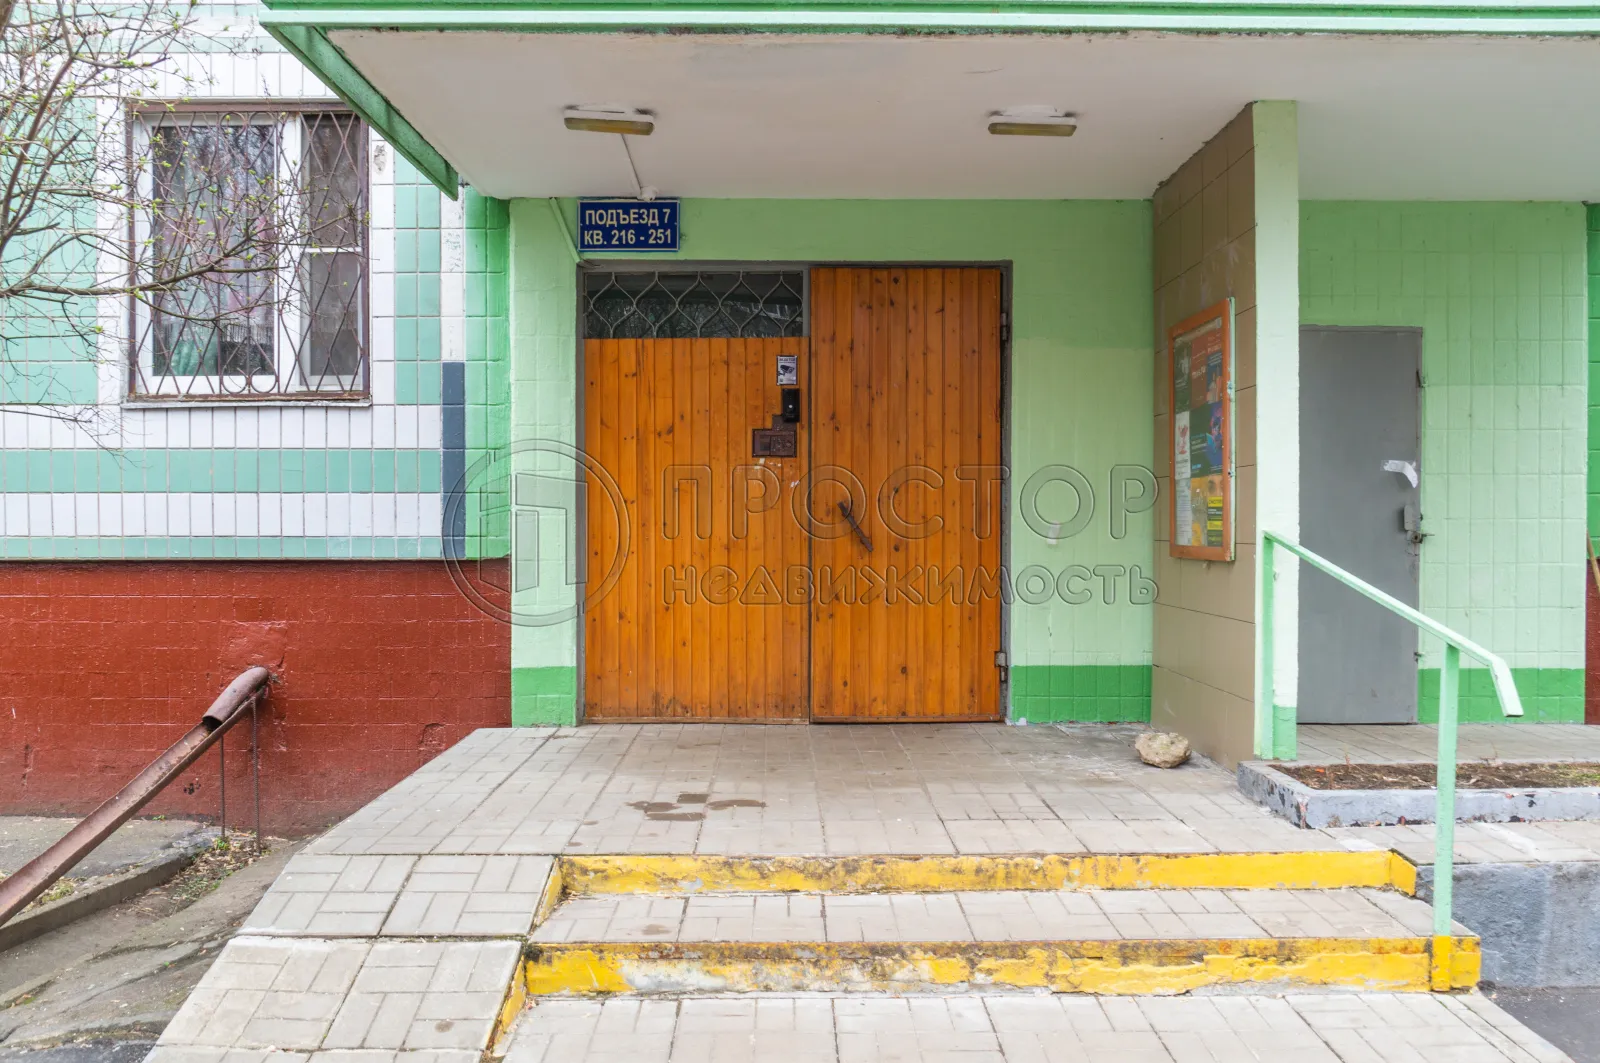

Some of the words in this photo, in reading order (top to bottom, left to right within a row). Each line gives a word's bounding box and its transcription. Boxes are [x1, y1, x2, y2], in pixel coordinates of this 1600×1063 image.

[585, 208, 659, 227] ПОДЪЕЗД
[662, 208, 671, 224] 7
[584, 230, 607, 245] КВ.
[611, 229, 636, 245] 216
[648, 229, 671, 244] 251
